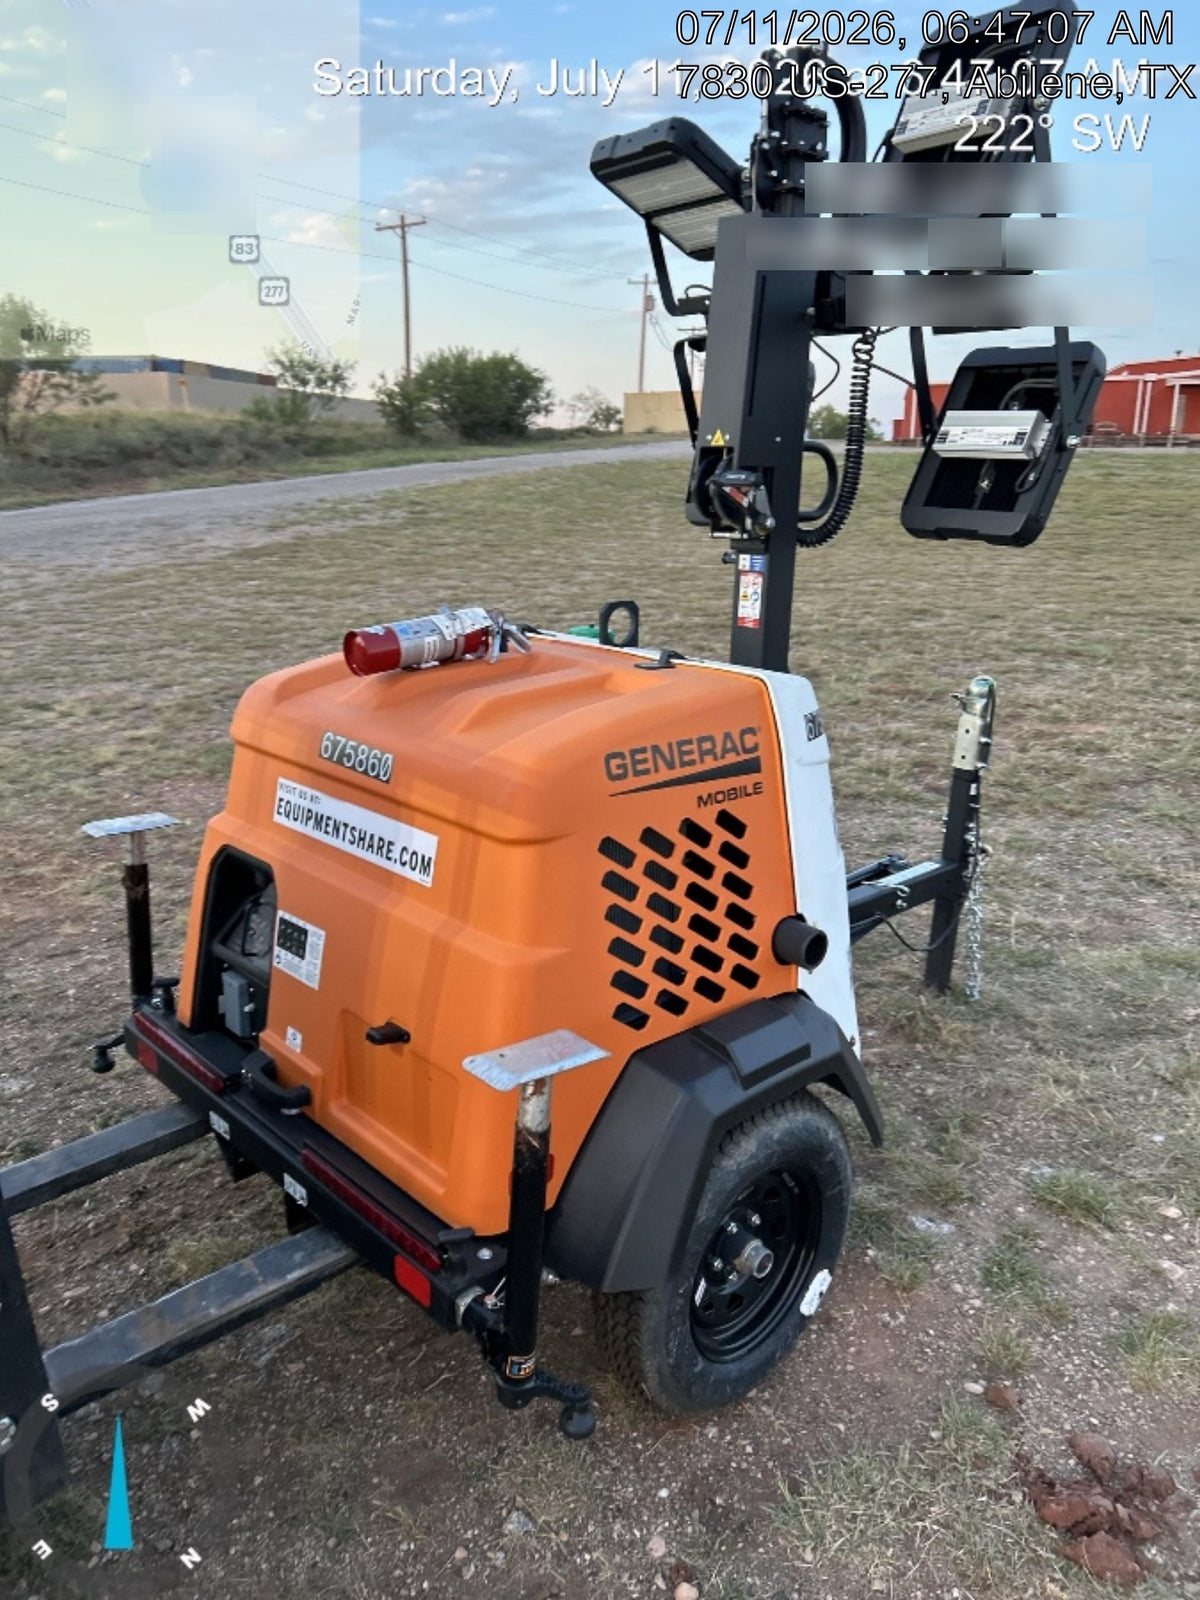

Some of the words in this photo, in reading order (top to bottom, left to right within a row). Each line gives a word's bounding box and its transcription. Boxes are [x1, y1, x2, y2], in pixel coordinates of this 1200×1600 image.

[321, 732, 393, 781] 675860
[604, 726, 759, 782] GENERAC
[697, 781, 763, 808] MOBILE
[276, 797, 432, 878] EQUIPMENTSHARE.COM
